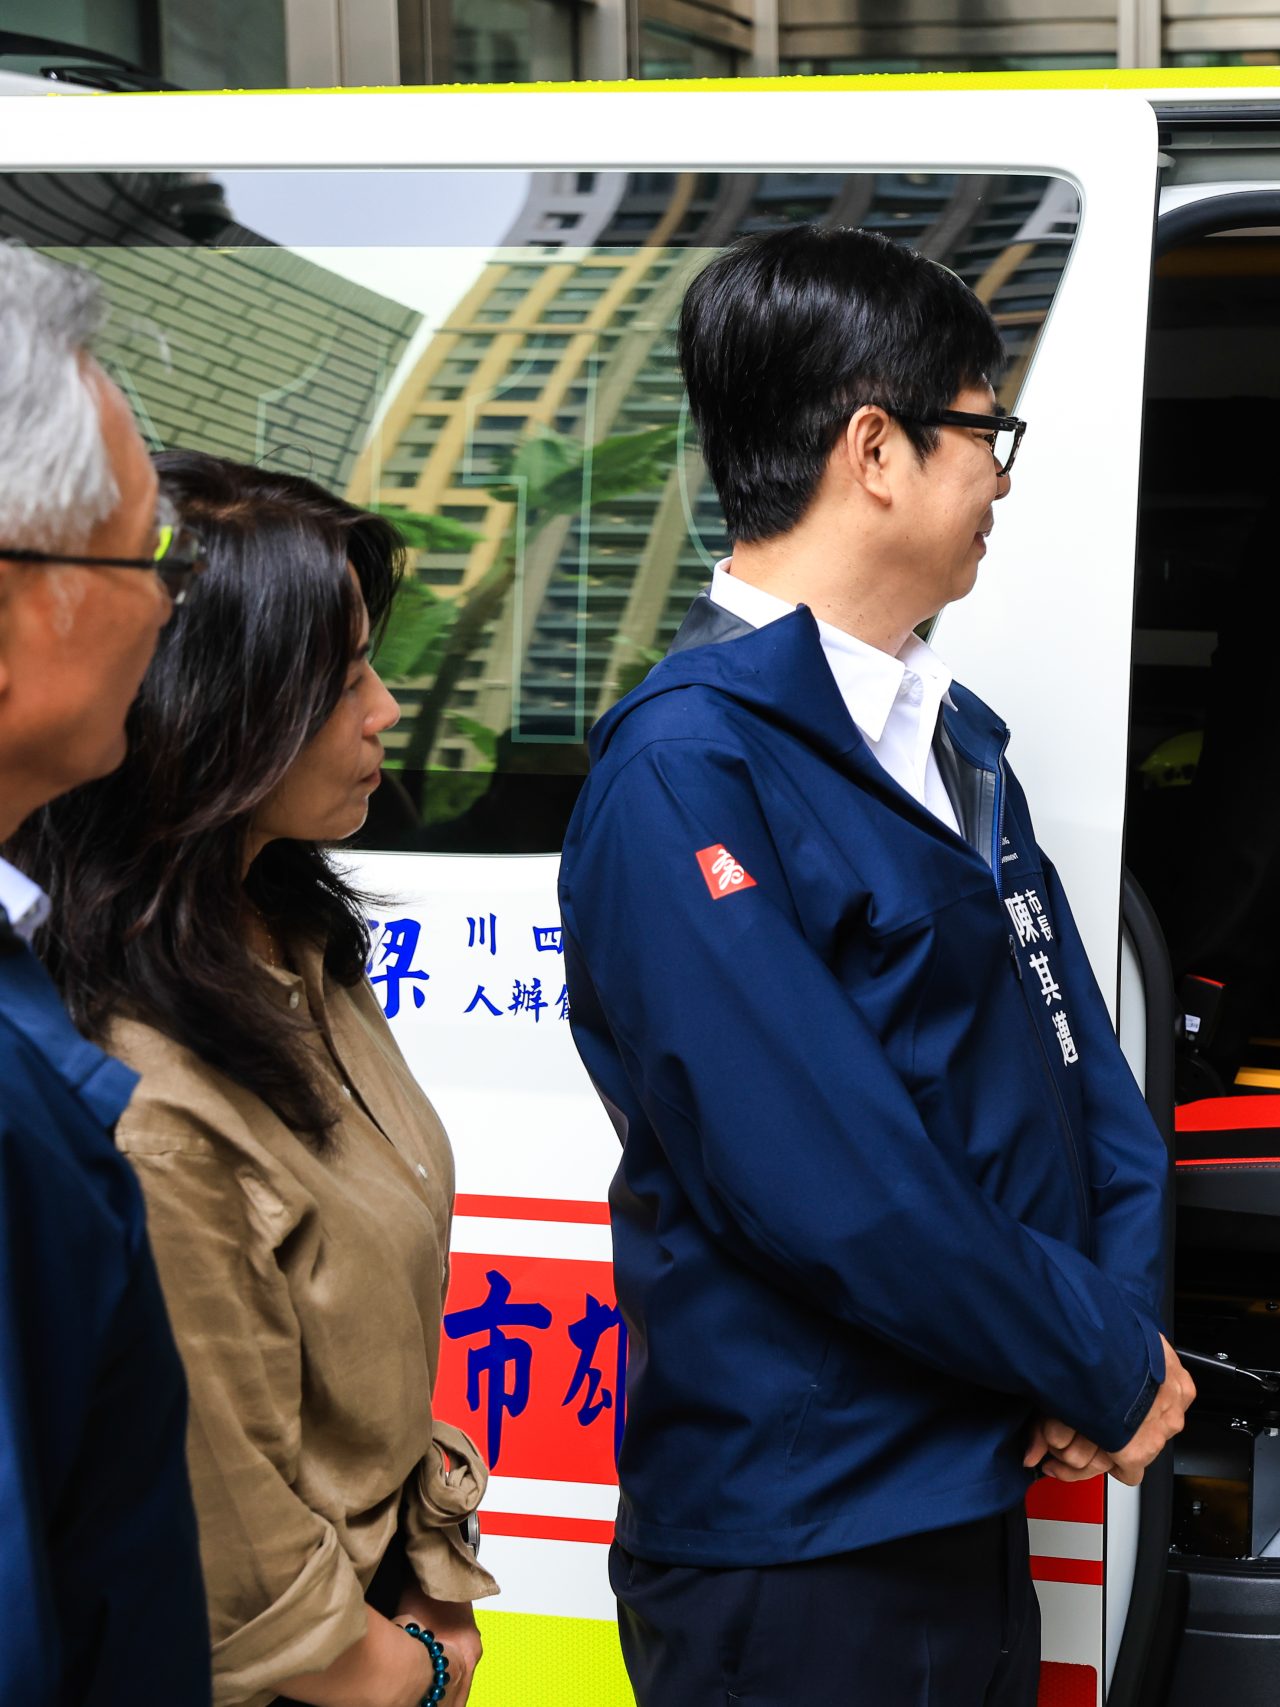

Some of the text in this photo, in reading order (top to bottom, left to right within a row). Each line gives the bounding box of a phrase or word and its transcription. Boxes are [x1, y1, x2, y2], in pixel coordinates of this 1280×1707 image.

[1025, 889, 1054, 942] 市長
[1004, 891, 1080, 1067] 陳其邁
